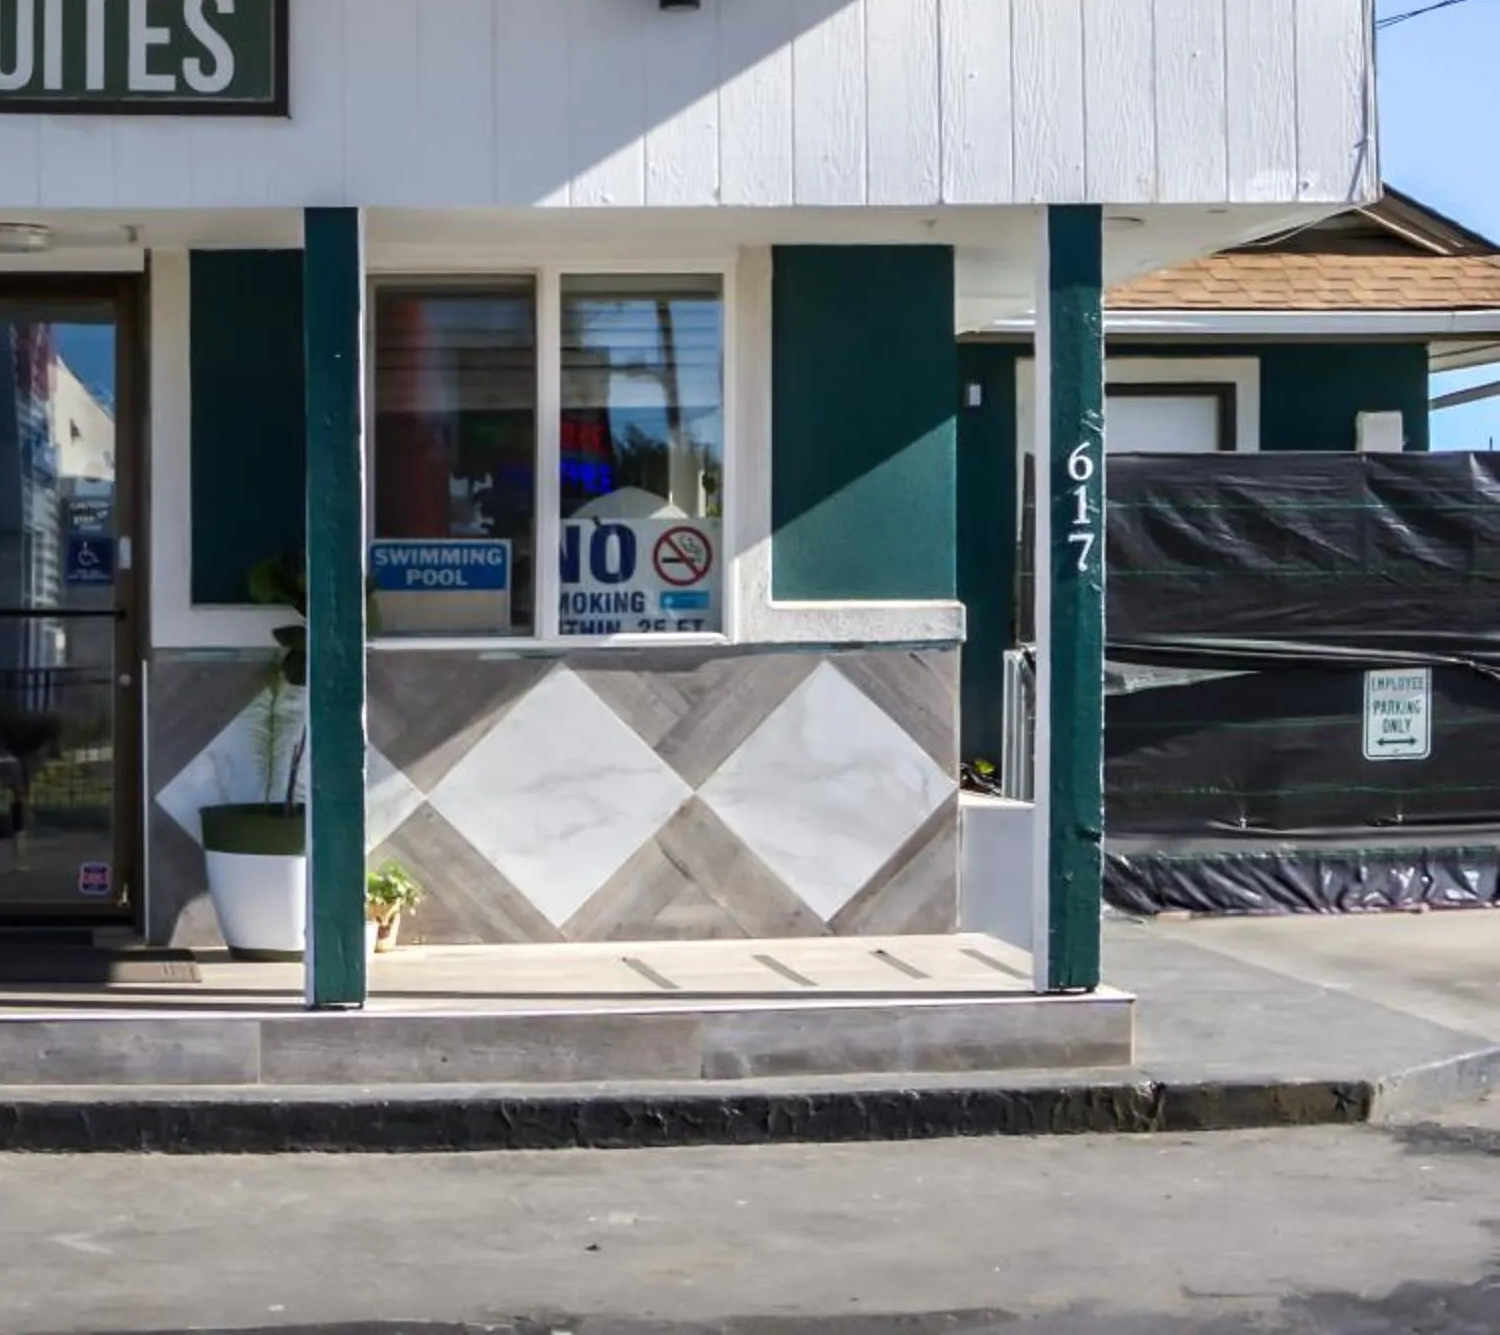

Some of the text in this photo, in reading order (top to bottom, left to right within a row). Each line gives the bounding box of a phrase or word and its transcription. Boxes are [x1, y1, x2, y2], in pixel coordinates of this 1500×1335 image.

[1067, 441, 1096, 572] 617
[374, 547, 504, 566] SWIMMING
[405, 568, 469, 586] POOL
[1371, 676, 1424, 691] EMPLOYEE
[1373, 699, 1421, 715] PARKING
[1381, 718, 1412, 733] ONLY
